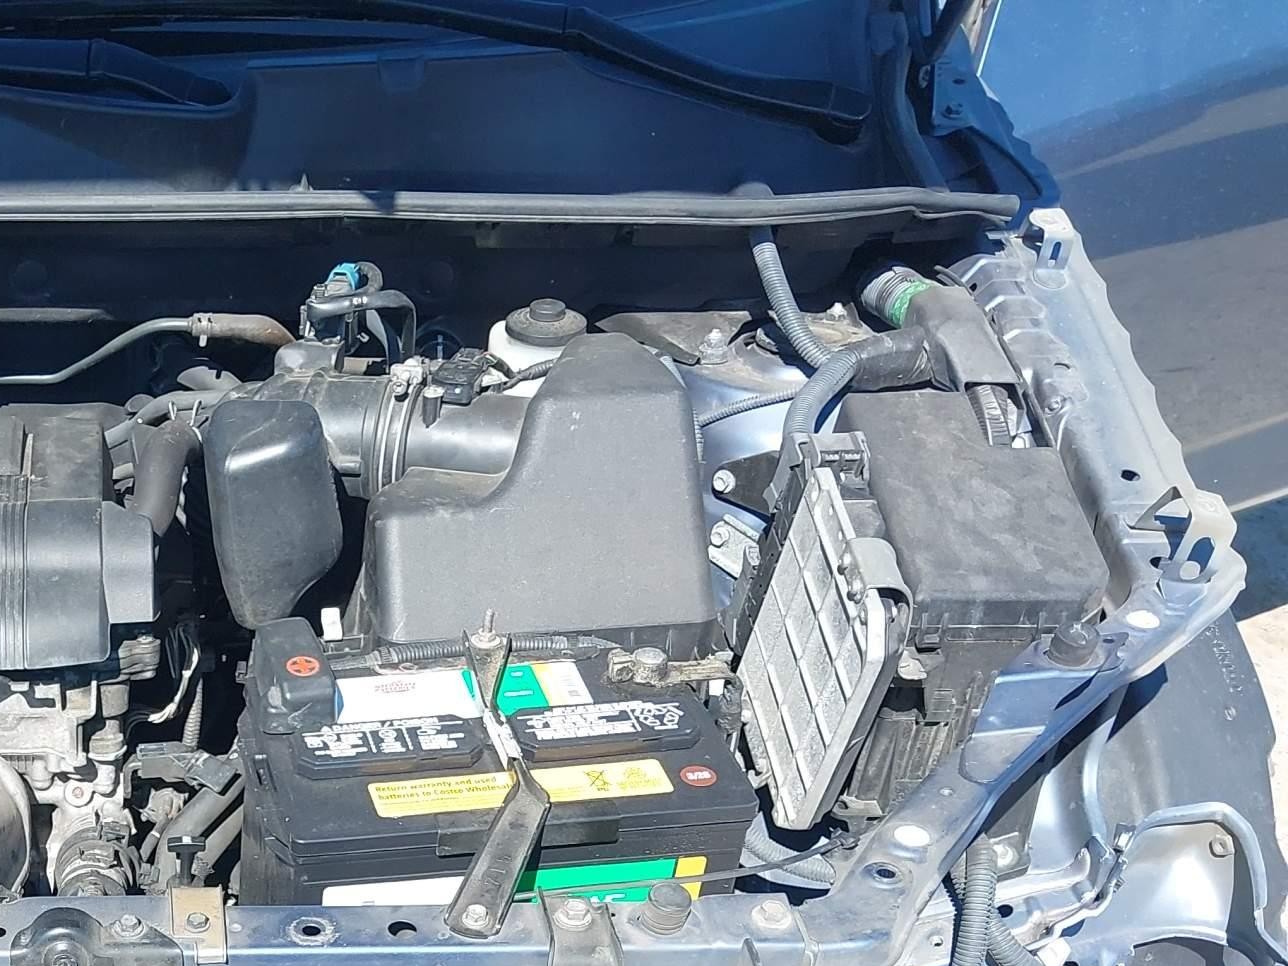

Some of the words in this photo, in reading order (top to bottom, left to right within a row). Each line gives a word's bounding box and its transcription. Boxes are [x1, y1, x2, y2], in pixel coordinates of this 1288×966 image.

[375, 783, 407, 793] Return
[410, 780, 453, 791] warranty
[455, 778, 473, 786] and
[474, 775, 497, 784] used
[378, 790, 420, 801] batteries
[422, 789, 432, 797] to
[433, 787, 464, 797] Costco
